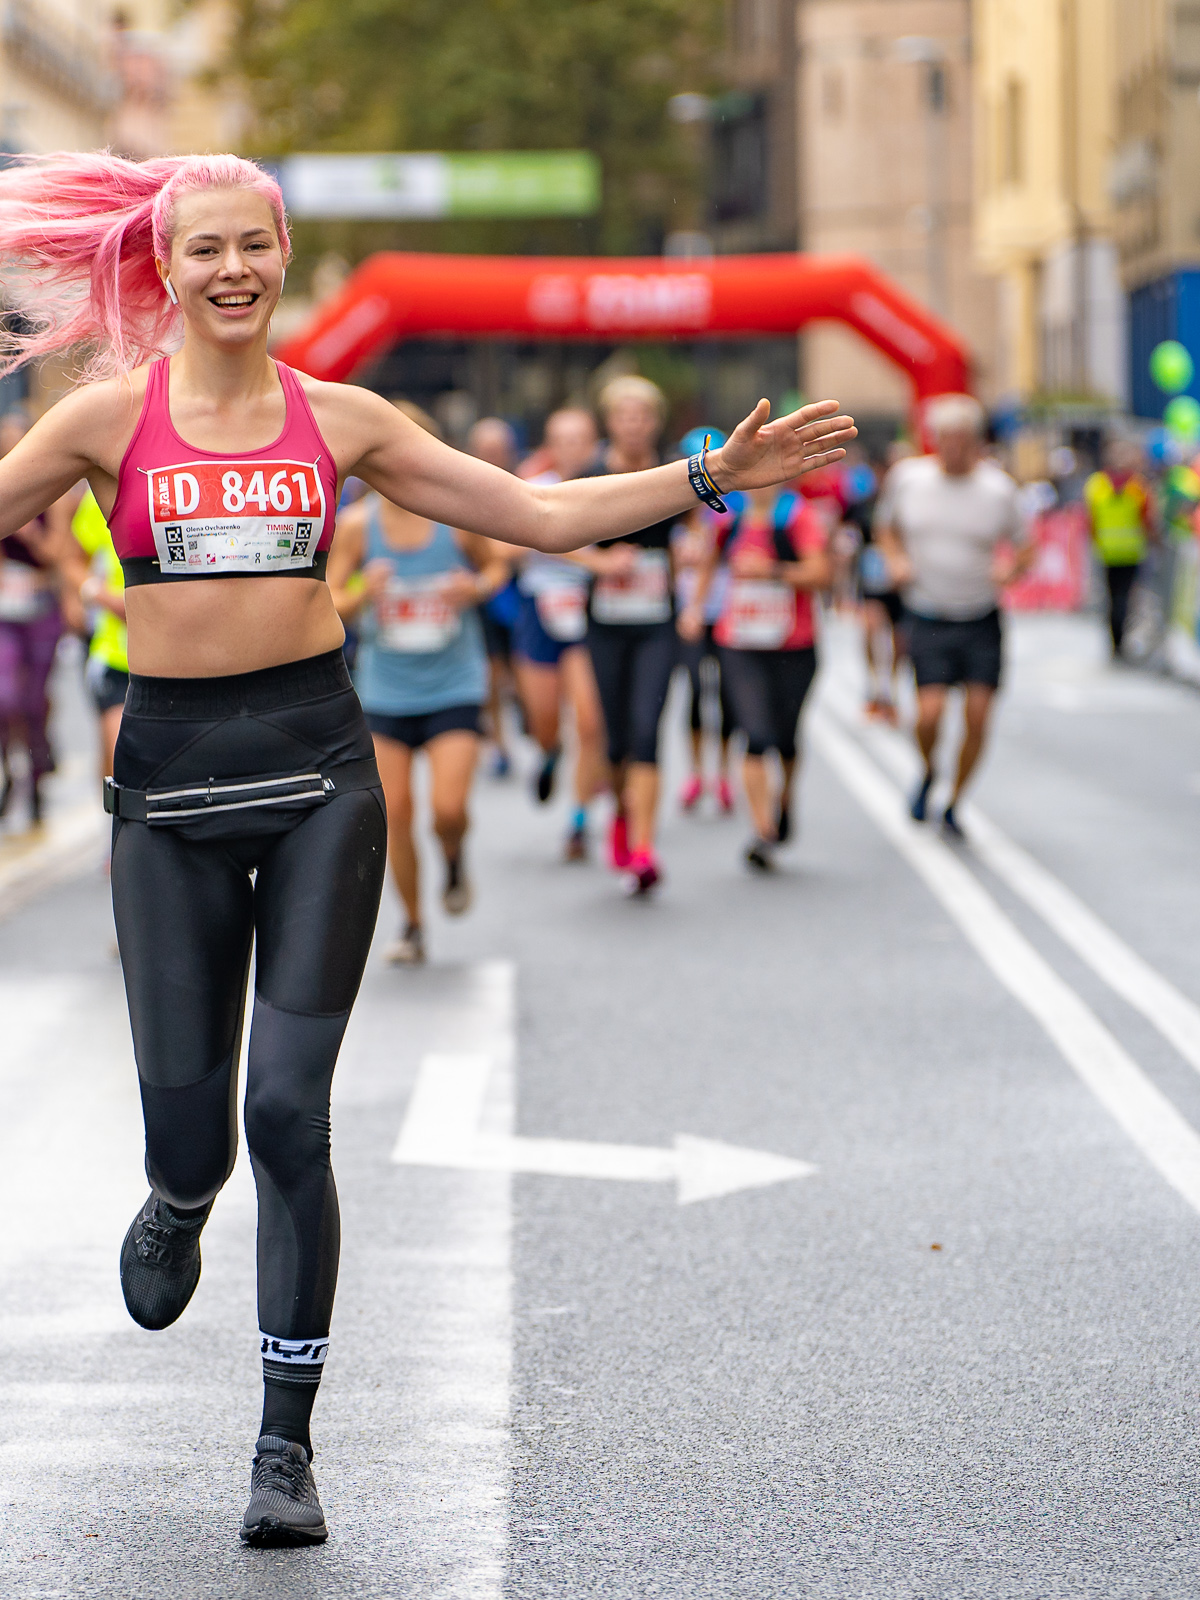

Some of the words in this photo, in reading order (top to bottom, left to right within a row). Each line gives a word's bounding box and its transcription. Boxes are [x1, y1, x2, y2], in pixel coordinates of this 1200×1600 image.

[173, 473, 200, 515] D
[221, 470, 311, 514] 8461
[186, 525, 203, 533] Olena
[204, 524, 241, 532] Ovcharenko
